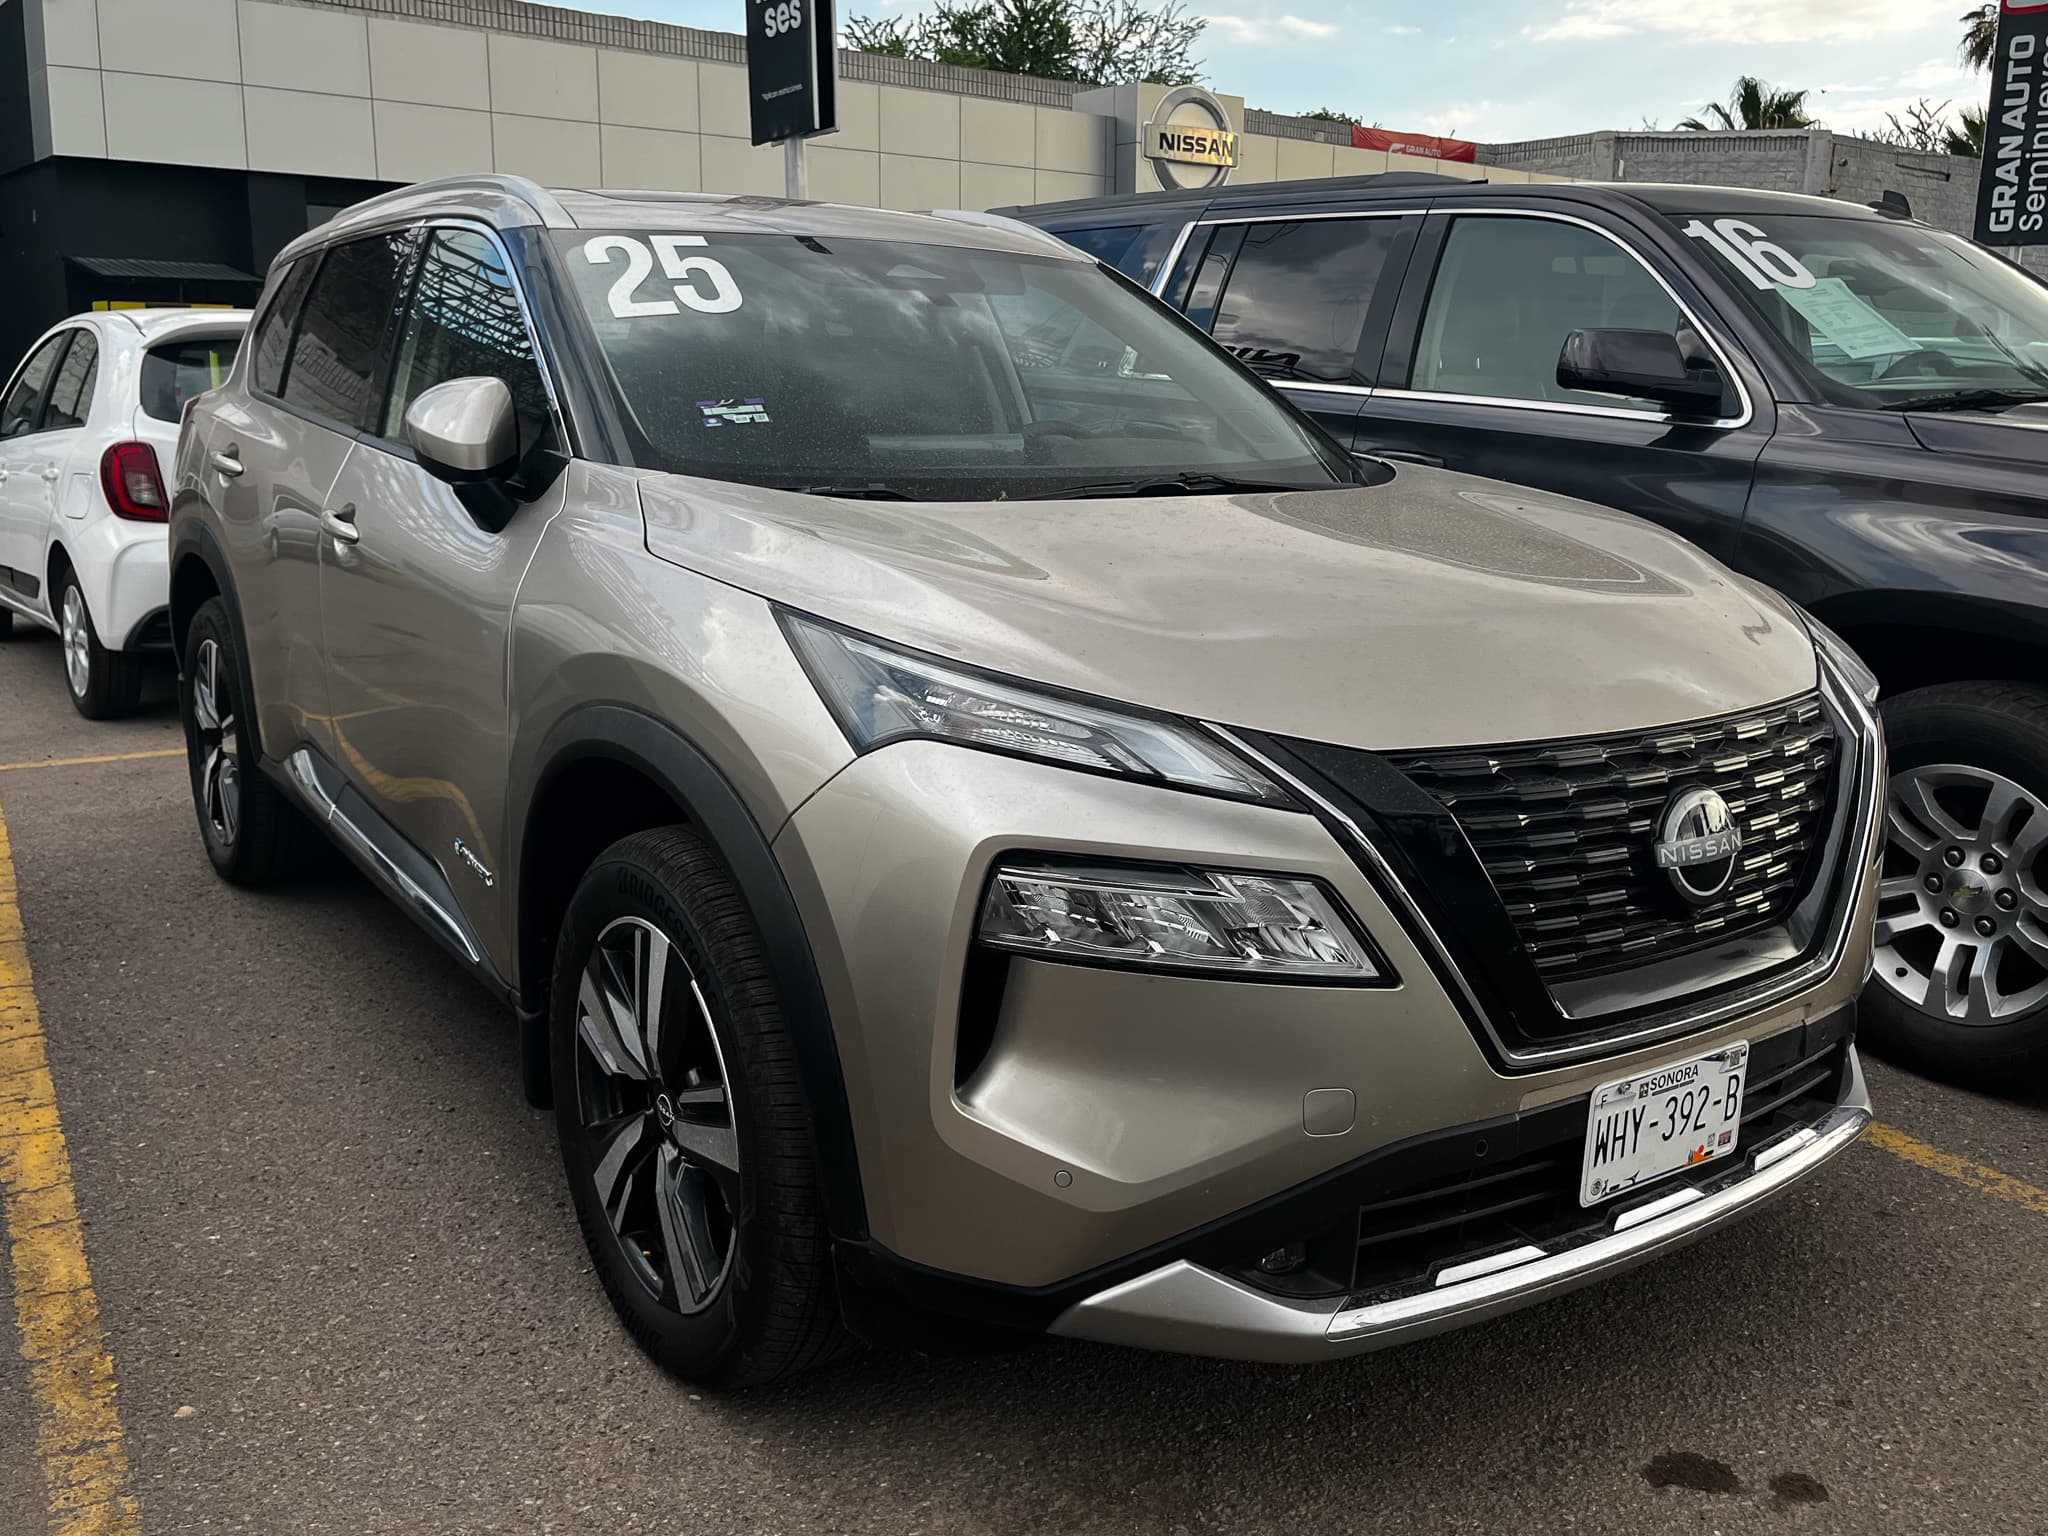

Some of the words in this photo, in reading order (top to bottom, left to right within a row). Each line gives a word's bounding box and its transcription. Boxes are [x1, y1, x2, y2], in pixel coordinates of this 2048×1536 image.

[764, 0, 802, 38] ses
[2001, 34, 2036, 131] AUTO
[1159, 132, 1233, 157] NISSAN
[2018, 34, 2048, 232] Seminu
[1989, 135, 2024, 233] GRAN
[583, 235, 743, 319] 25
[1681, 218, 1817, 291] 16
[1659, 831, 1741, 864] NISSAN
[1649, 1064, 1699, 1091] SONORA
[1593, 1073, 1741, 1169] WHY-392-B
